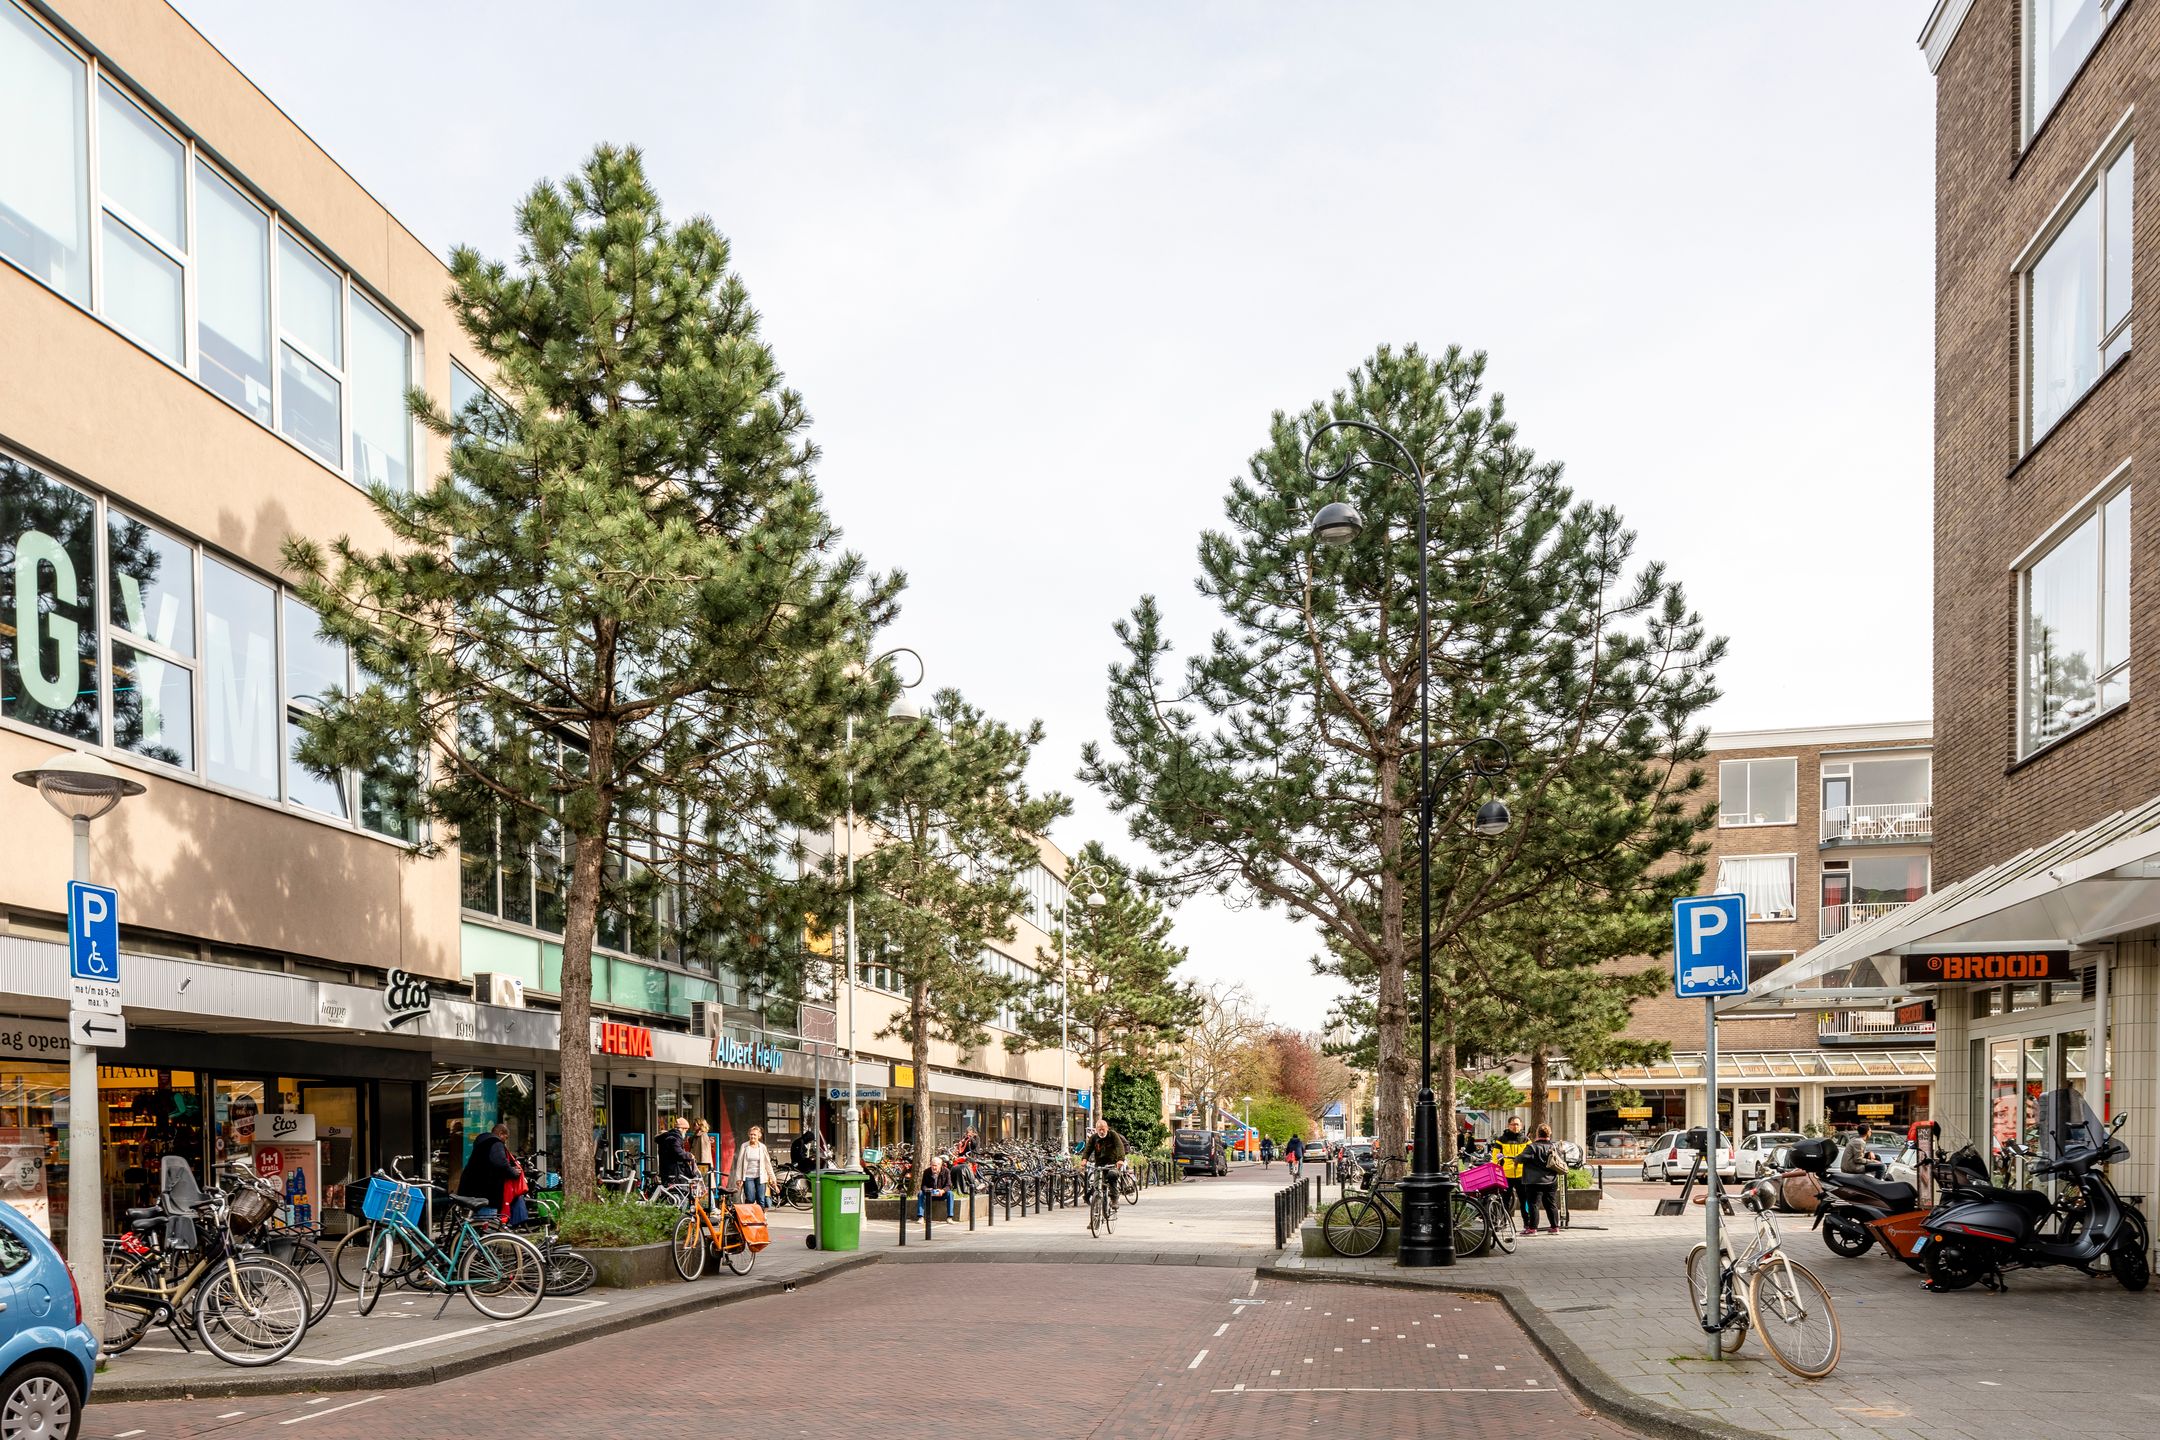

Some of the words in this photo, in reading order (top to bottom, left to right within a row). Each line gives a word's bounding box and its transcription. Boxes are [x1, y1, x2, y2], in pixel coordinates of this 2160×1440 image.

[15, 530, 272, 780] GYM
[83, 892, 107, 937] P
[1690, 905, 1728, 955] P
[1943, 954, 2048, 979] BROOD
[75, 985, 84, 993] ma
[387, 968, 431, 1010] Etos
[321, 1001, 347, 1018] happy
[1900, 1002, 1922, 1025] BROOD
[456, 1022, 474, 1038] 1919
[603, 1022, 653, 1057] HEMA
[28, 1034, 71, 1052] open
[716, 1036, 753, 1065] Albert
[756, 1042, 783, 1073] Heijn
[1081, 1095, 1087, 1104] P
[272, 1115, 297, 1132] Etos
[260, 1152, 280, 1165] 1+1
[261, 1164, 280, 1172] gratis
